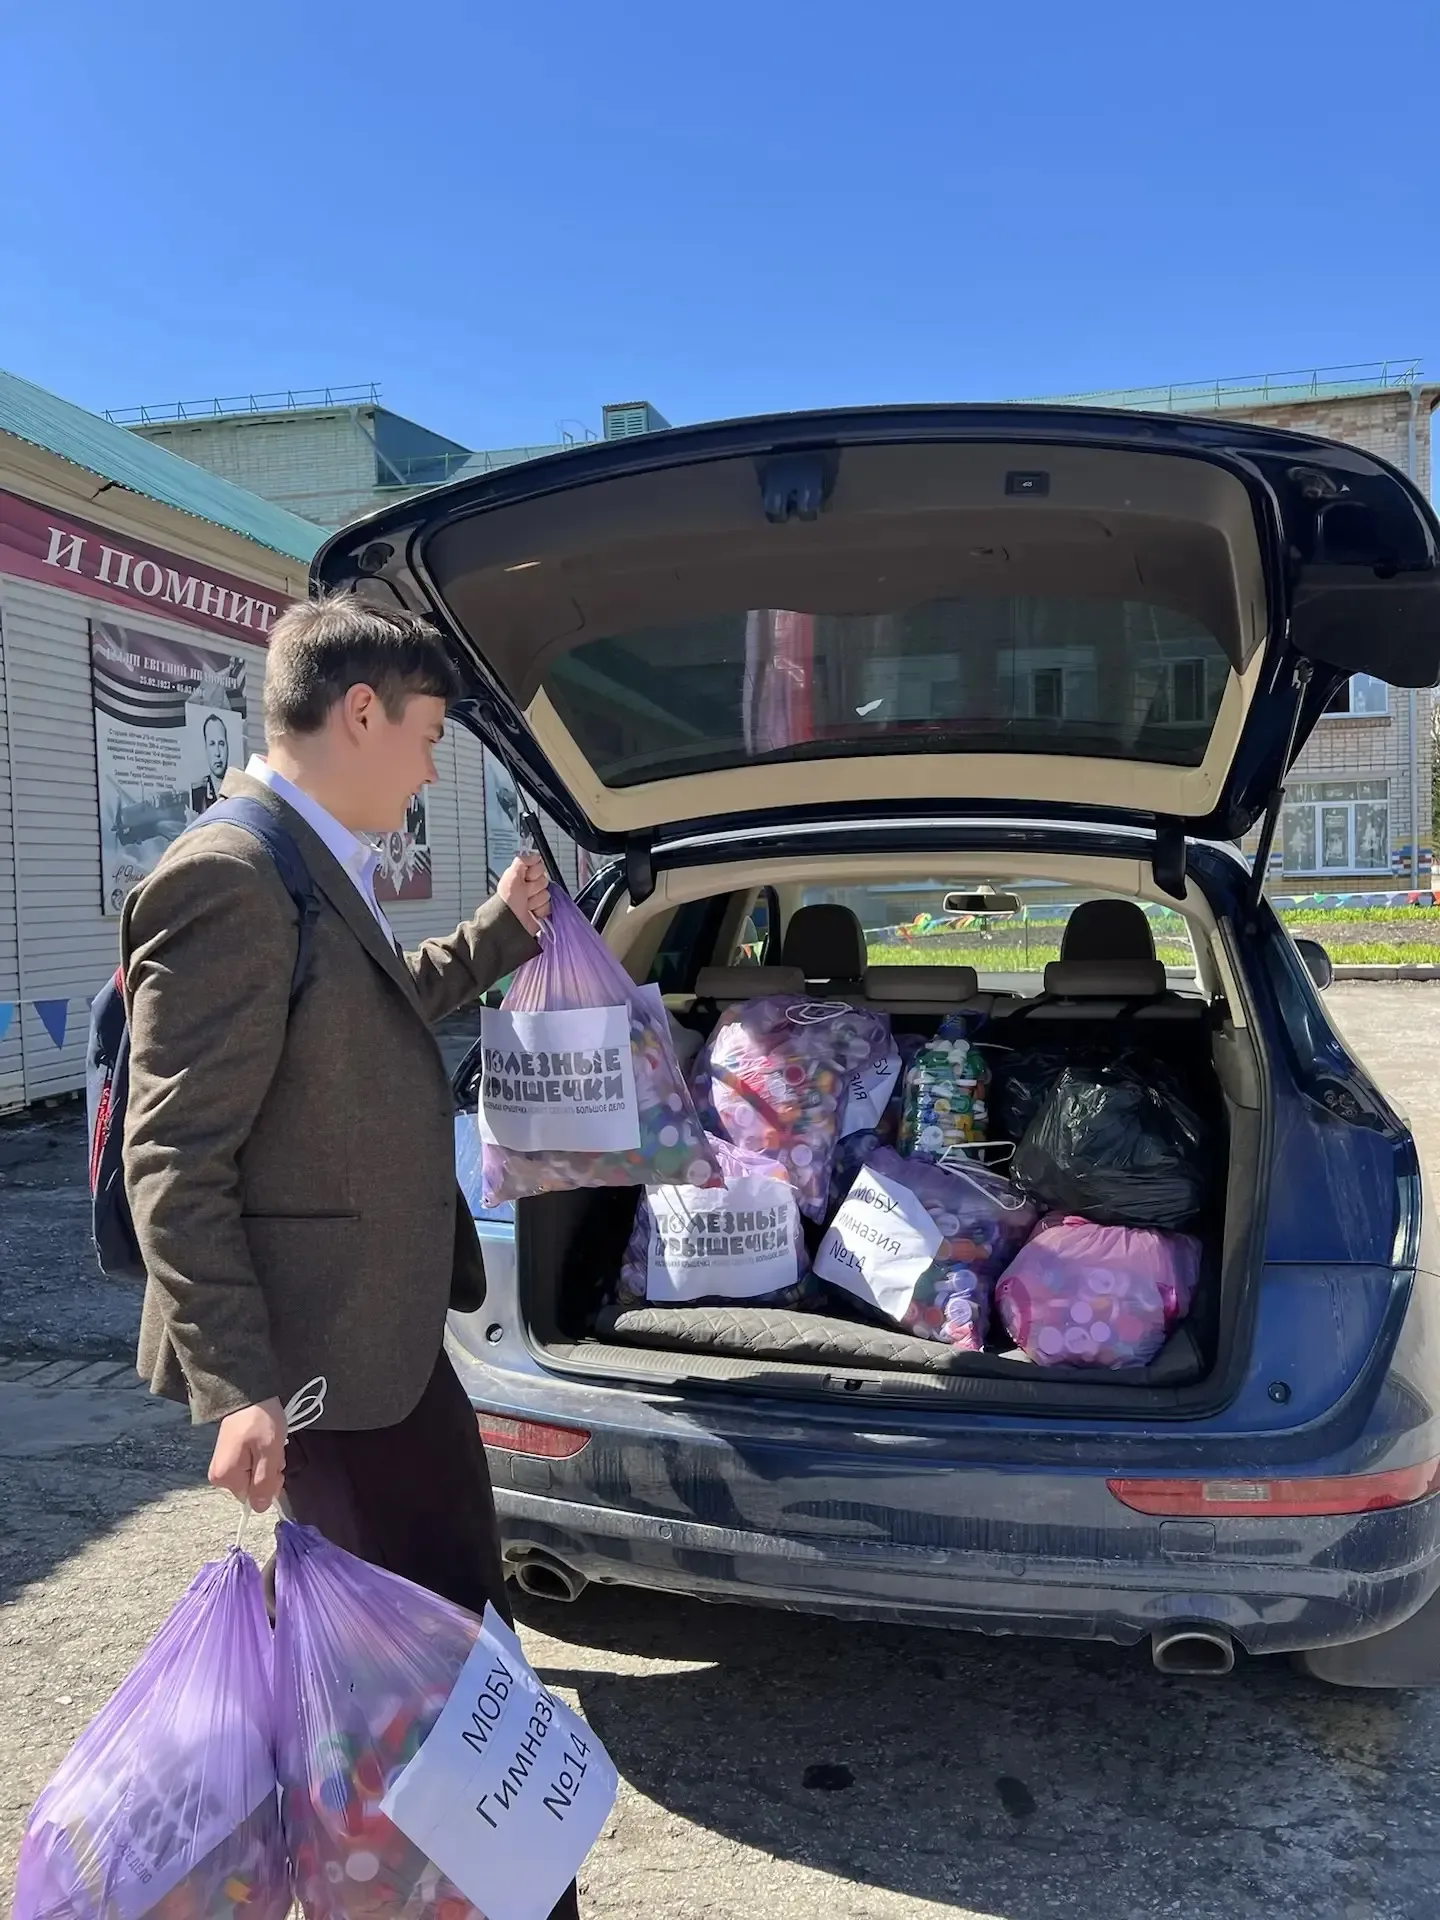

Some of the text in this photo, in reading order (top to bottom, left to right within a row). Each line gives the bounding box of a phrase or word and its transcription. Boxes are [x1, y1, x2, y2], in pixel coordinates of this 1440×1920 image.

[42, 526, 88, 574] И
[484, 1048, 622, 1078] ПОЛЕЗНЫЕ
[483, 1073, 624, 1102] КРЫШЕЧКИ
[576, 1103, 607, 1114] БОЛЬШОЕ
[608, 1102, 626, 1112] ДЕЛО
[852, 1181, 899, 1214] МОБУ
[656, 1204, 788, 1234] ПОЛЕЗНЫЕ
[837, 1211, 902, 1256] имназия
[655, 1225, 788, 1258] КРЫШЕЧКИ
[829, 1239, 867, 1273] №14
[461, 1657, 515, 1754] МОБУ
[475, 1692, 556, 1829] Гимнази
[542, 1733, 592, 1821] №14
